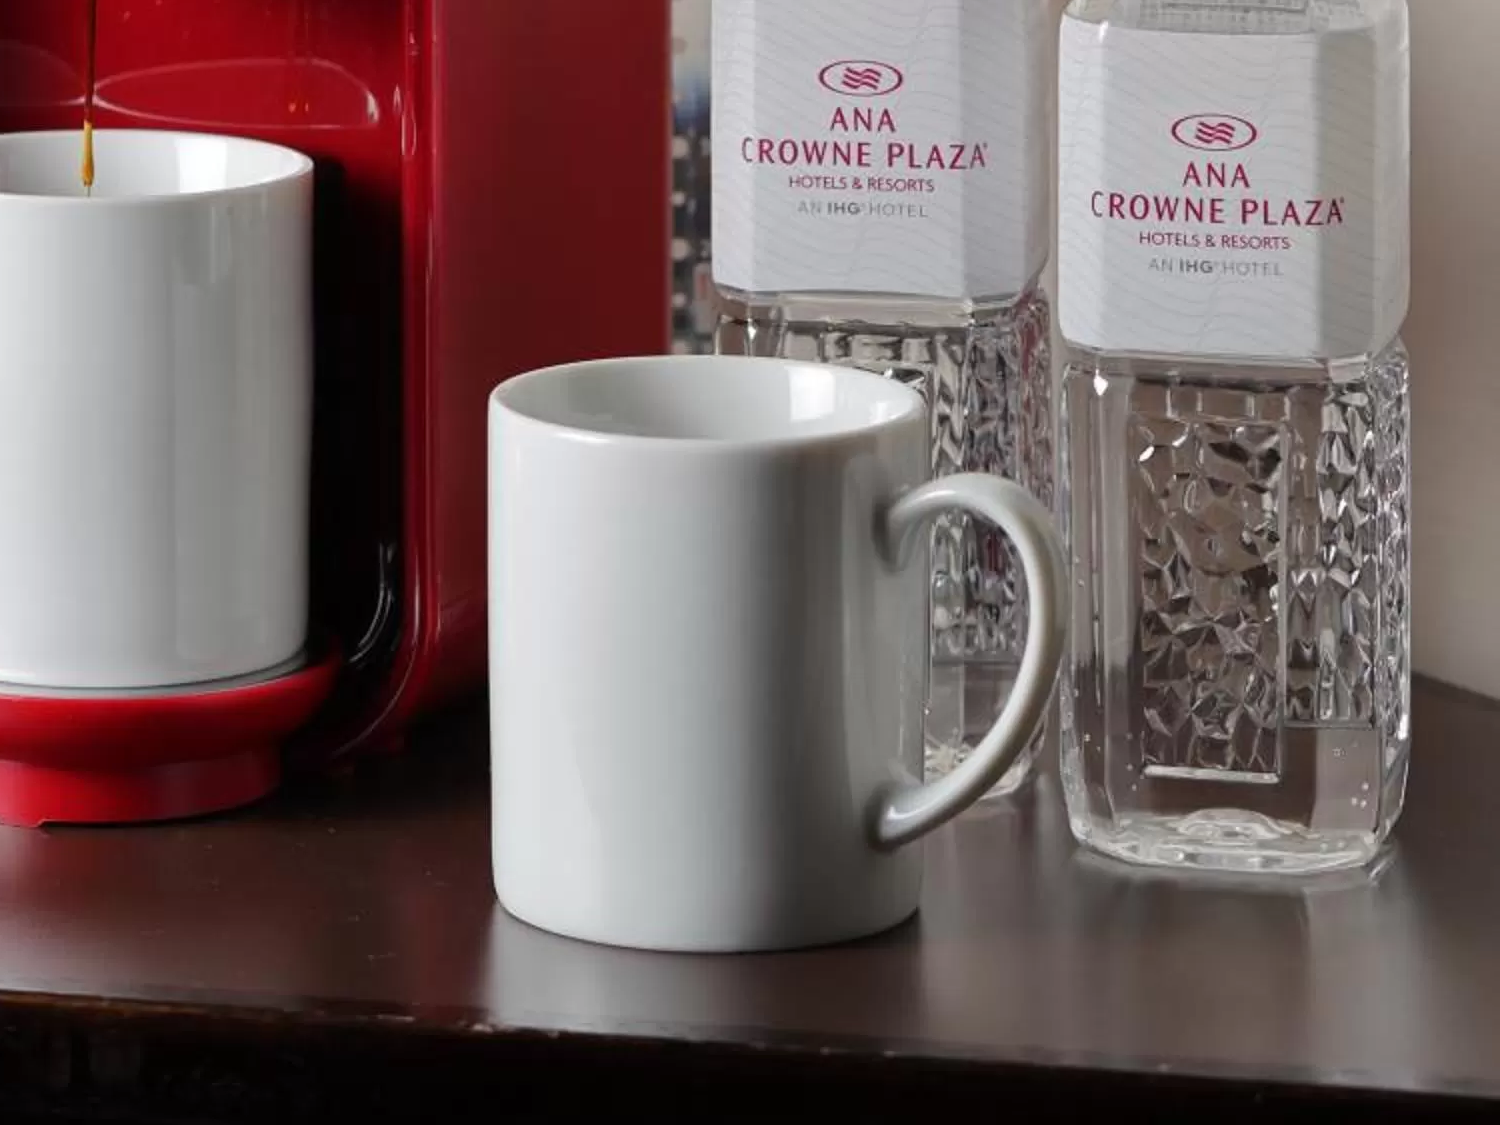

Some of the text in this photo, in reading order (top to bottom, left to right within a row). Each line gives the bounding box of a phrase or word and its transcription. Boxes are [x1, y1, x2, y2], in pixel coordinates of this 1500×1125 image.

[830, 106, 897, 133] ANA
[742, 137, 987, 170] CROWNE PLAZA
[789, 176, 935, 193] HOTELS & RESORTS
[1182, 162, 1250, 189] ANA
[798, 202, 929, 218] AN IHG HOTEL
[1091, 191, 1344, 226] CROWNE PLAZA
[1139, 231, 1292, 250] HOTELS & RESORTS
[1149, 259, 1284, 277] AN IHG HOTEL
